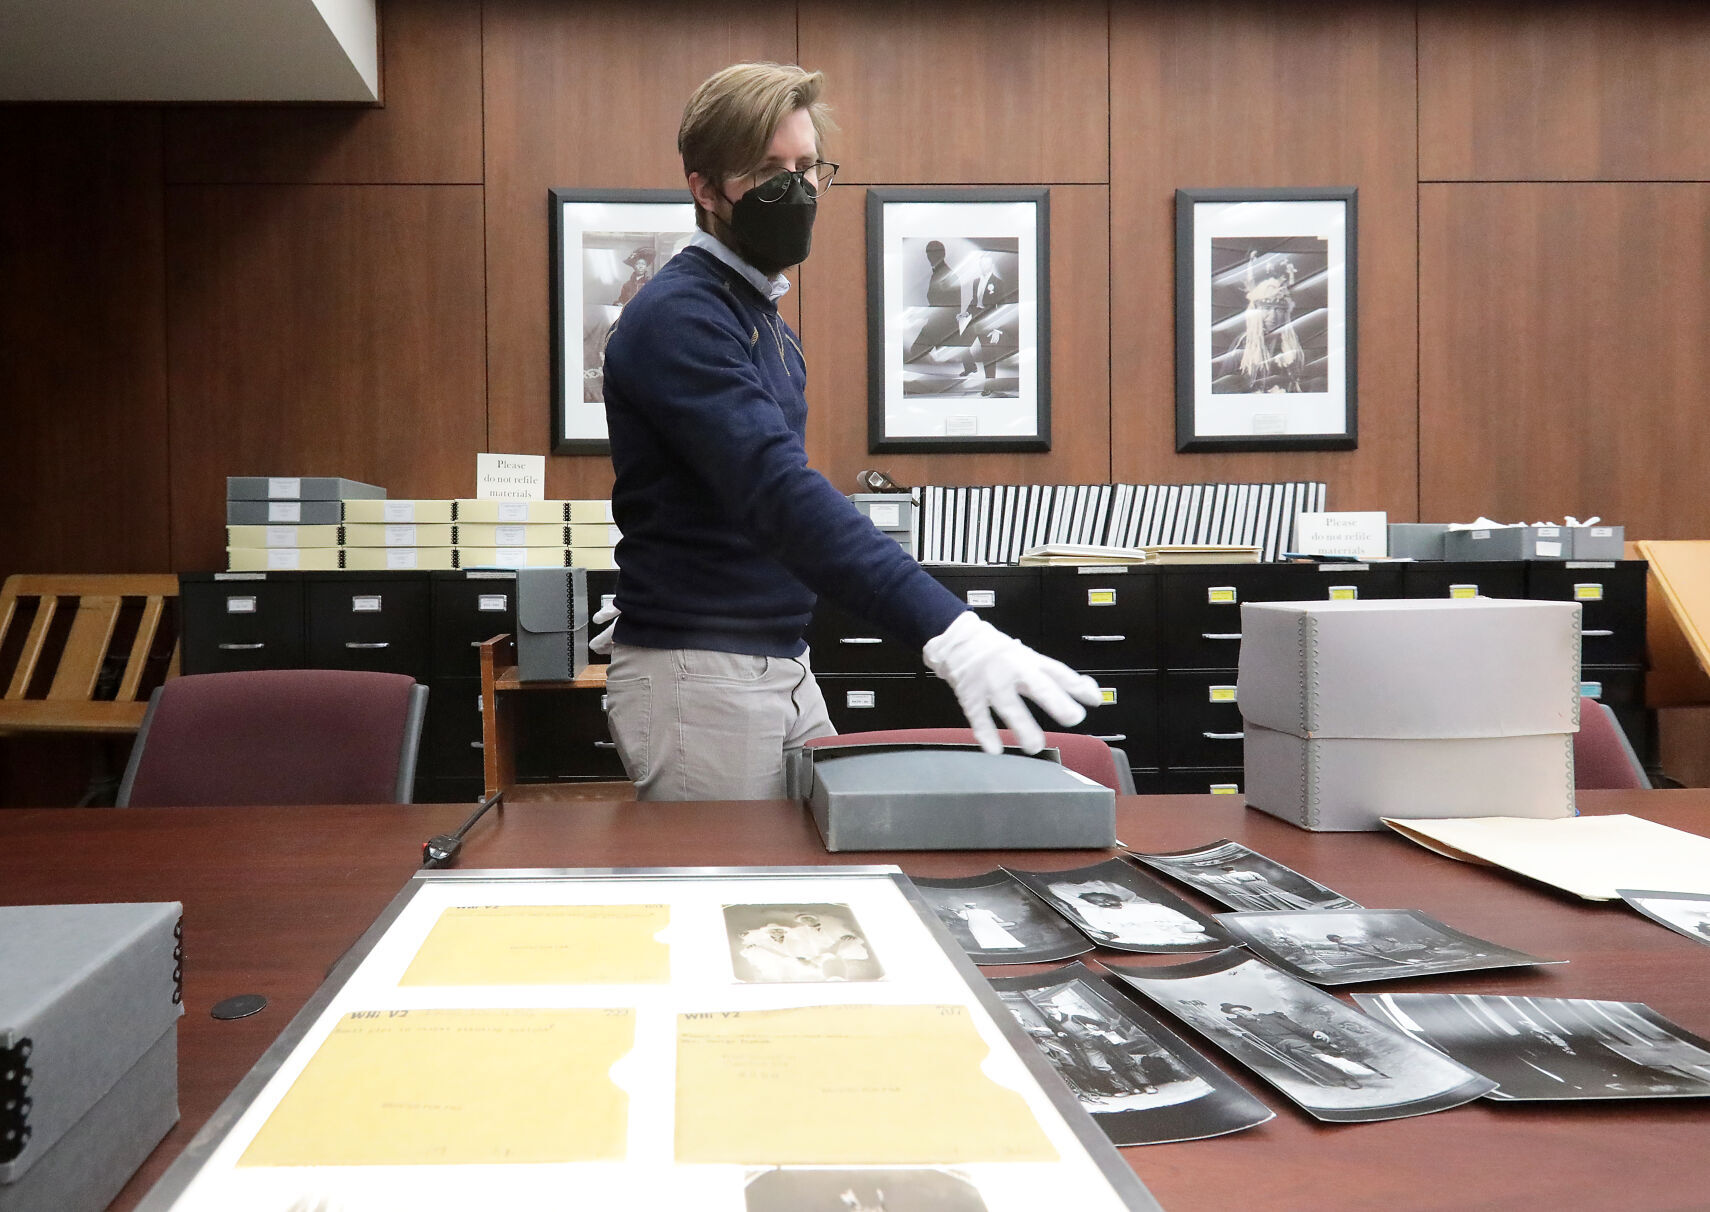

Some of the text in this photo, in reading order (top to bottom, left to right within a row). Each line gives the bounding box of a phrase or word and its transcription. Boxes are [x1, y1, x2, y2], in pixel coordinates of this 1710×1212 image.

[497, 459, 527, 470] Please
[483, 473, 539, 485] do not refile
[489, 489, 532, 499] materials
[1325, 517, 1359, 527] Please
[1311, 531, 1372, 541] do not refile
[1317, 546, 1366, 555] materials
[388, 1010, 409, 1018] V2
